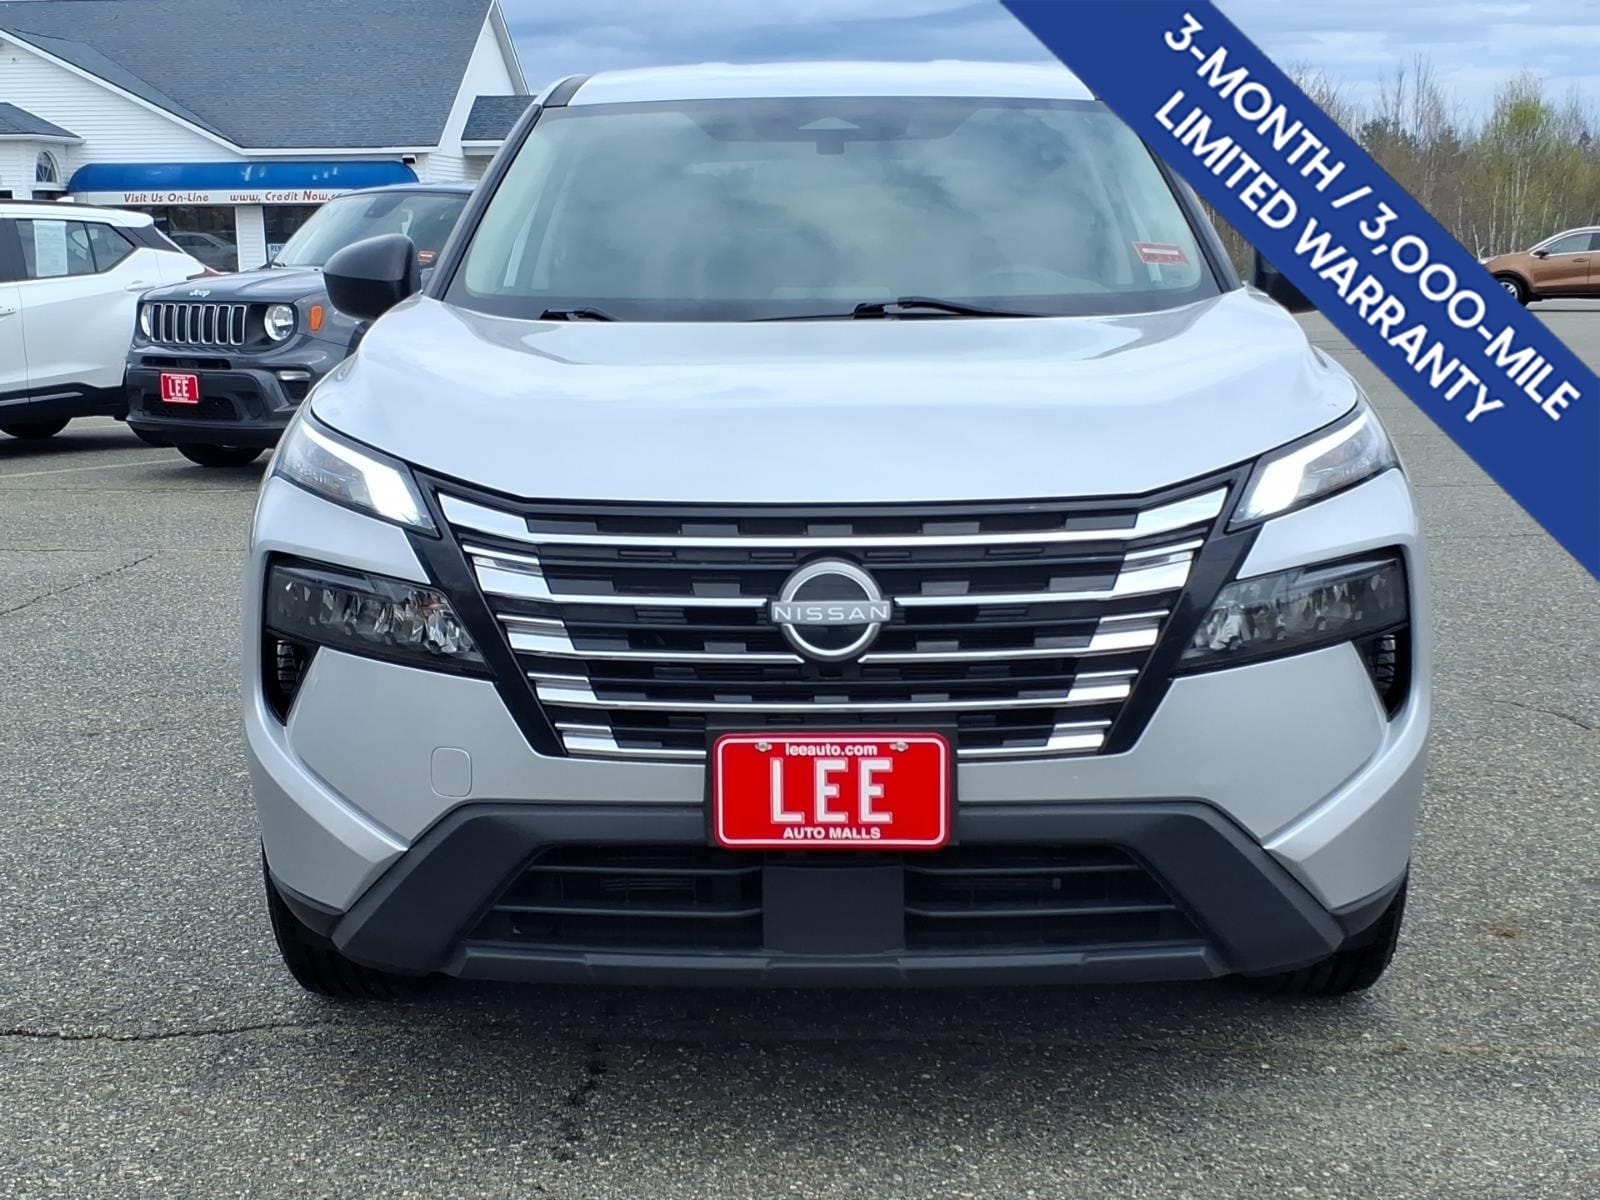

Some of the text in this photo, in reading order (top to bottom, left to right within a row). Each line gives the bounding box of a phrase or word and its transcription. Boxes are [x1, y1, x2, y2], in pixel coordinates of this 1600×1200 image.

[124, 192, 209, 202] Visit Us On-Line
[265, 191, 298, 201] Credit
[168, 379, 190, 397] LEE
[773, 605, 888, 622] NISSAN
[785, 743, 878, 756] leeauto.com
[770, 757, 893, 824] LEE
[783, 828, 881, 839] AUTO MALLS
